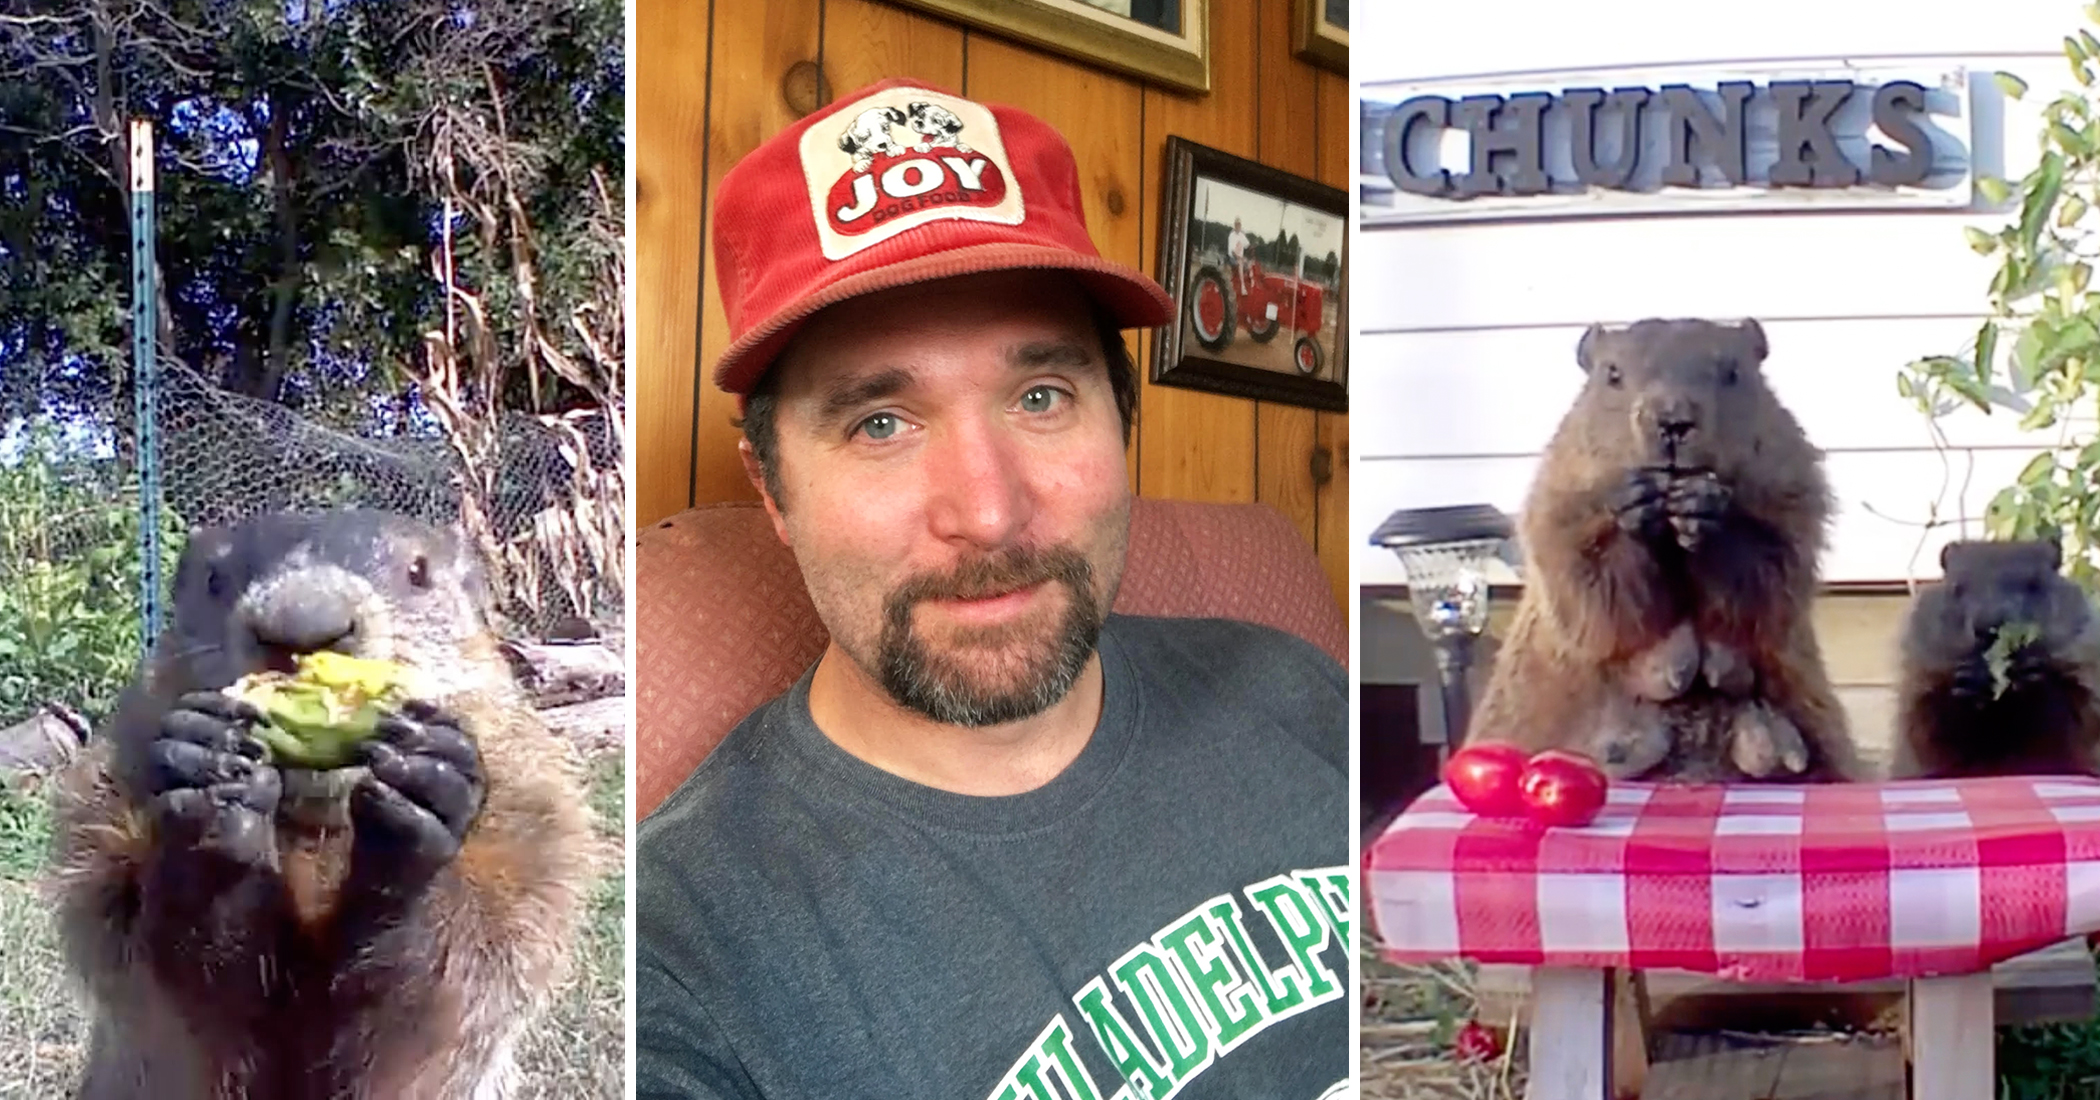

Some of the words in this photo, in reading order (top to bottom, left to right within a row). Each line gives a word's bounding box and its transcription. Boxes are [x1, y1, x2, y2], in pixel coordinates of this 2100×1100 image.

[1382, 79, 1933, 199] CHUNKS
[835, 156, 988, 224] JOY
[872, 200, 915, 224] DOG
[917, 191, 970, 208] FOOD
[984, 866, 1349, 1100] LADELP
